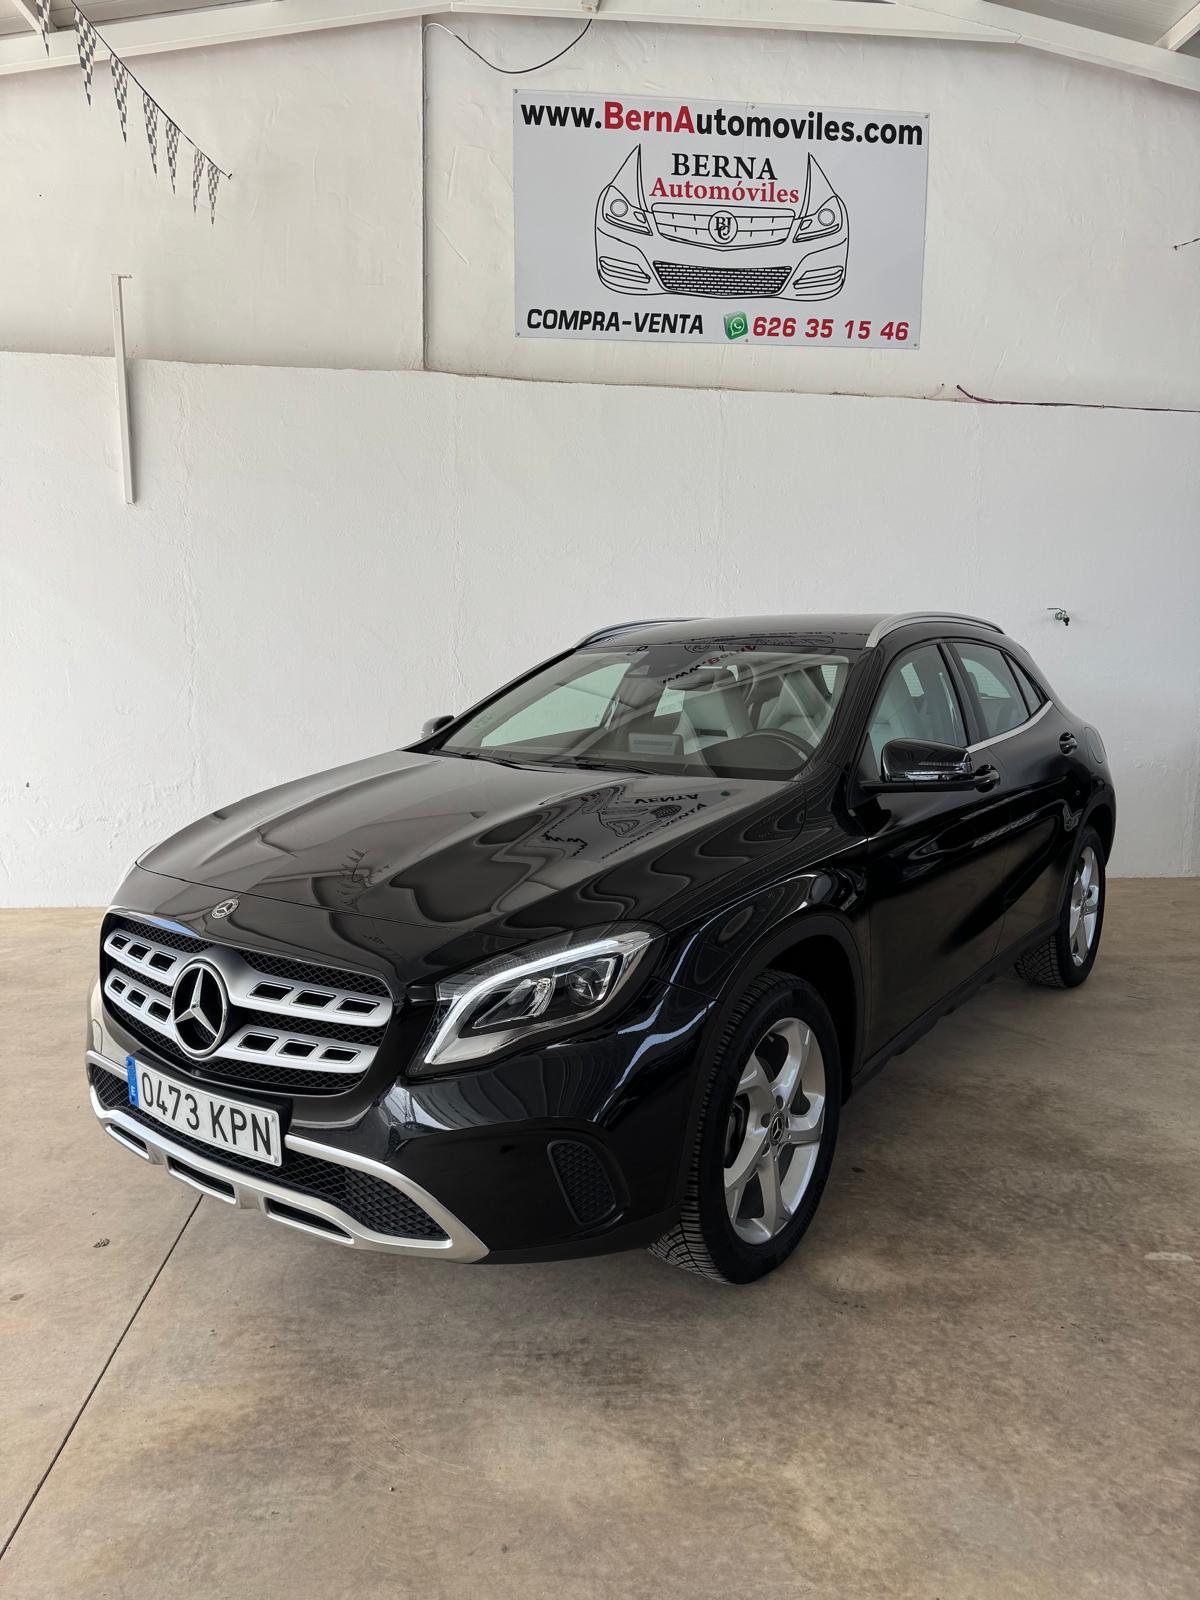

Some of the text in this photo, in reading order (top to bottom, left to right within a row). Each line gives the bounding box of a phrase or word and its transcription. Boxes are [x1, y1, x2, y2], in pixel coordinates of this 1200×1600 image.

[520, 101, 923, 146] www.BernAutomoviles.com
[671, 153, 778, 180] BERNA
[649, 177, 799, 203] Automóviles
[526, 308, 704, 335] COMPRA-VENTA
[753, 316, 910, 341] 626 35 15 46
[141, 1072, 272, 1156] 0473 KPN
